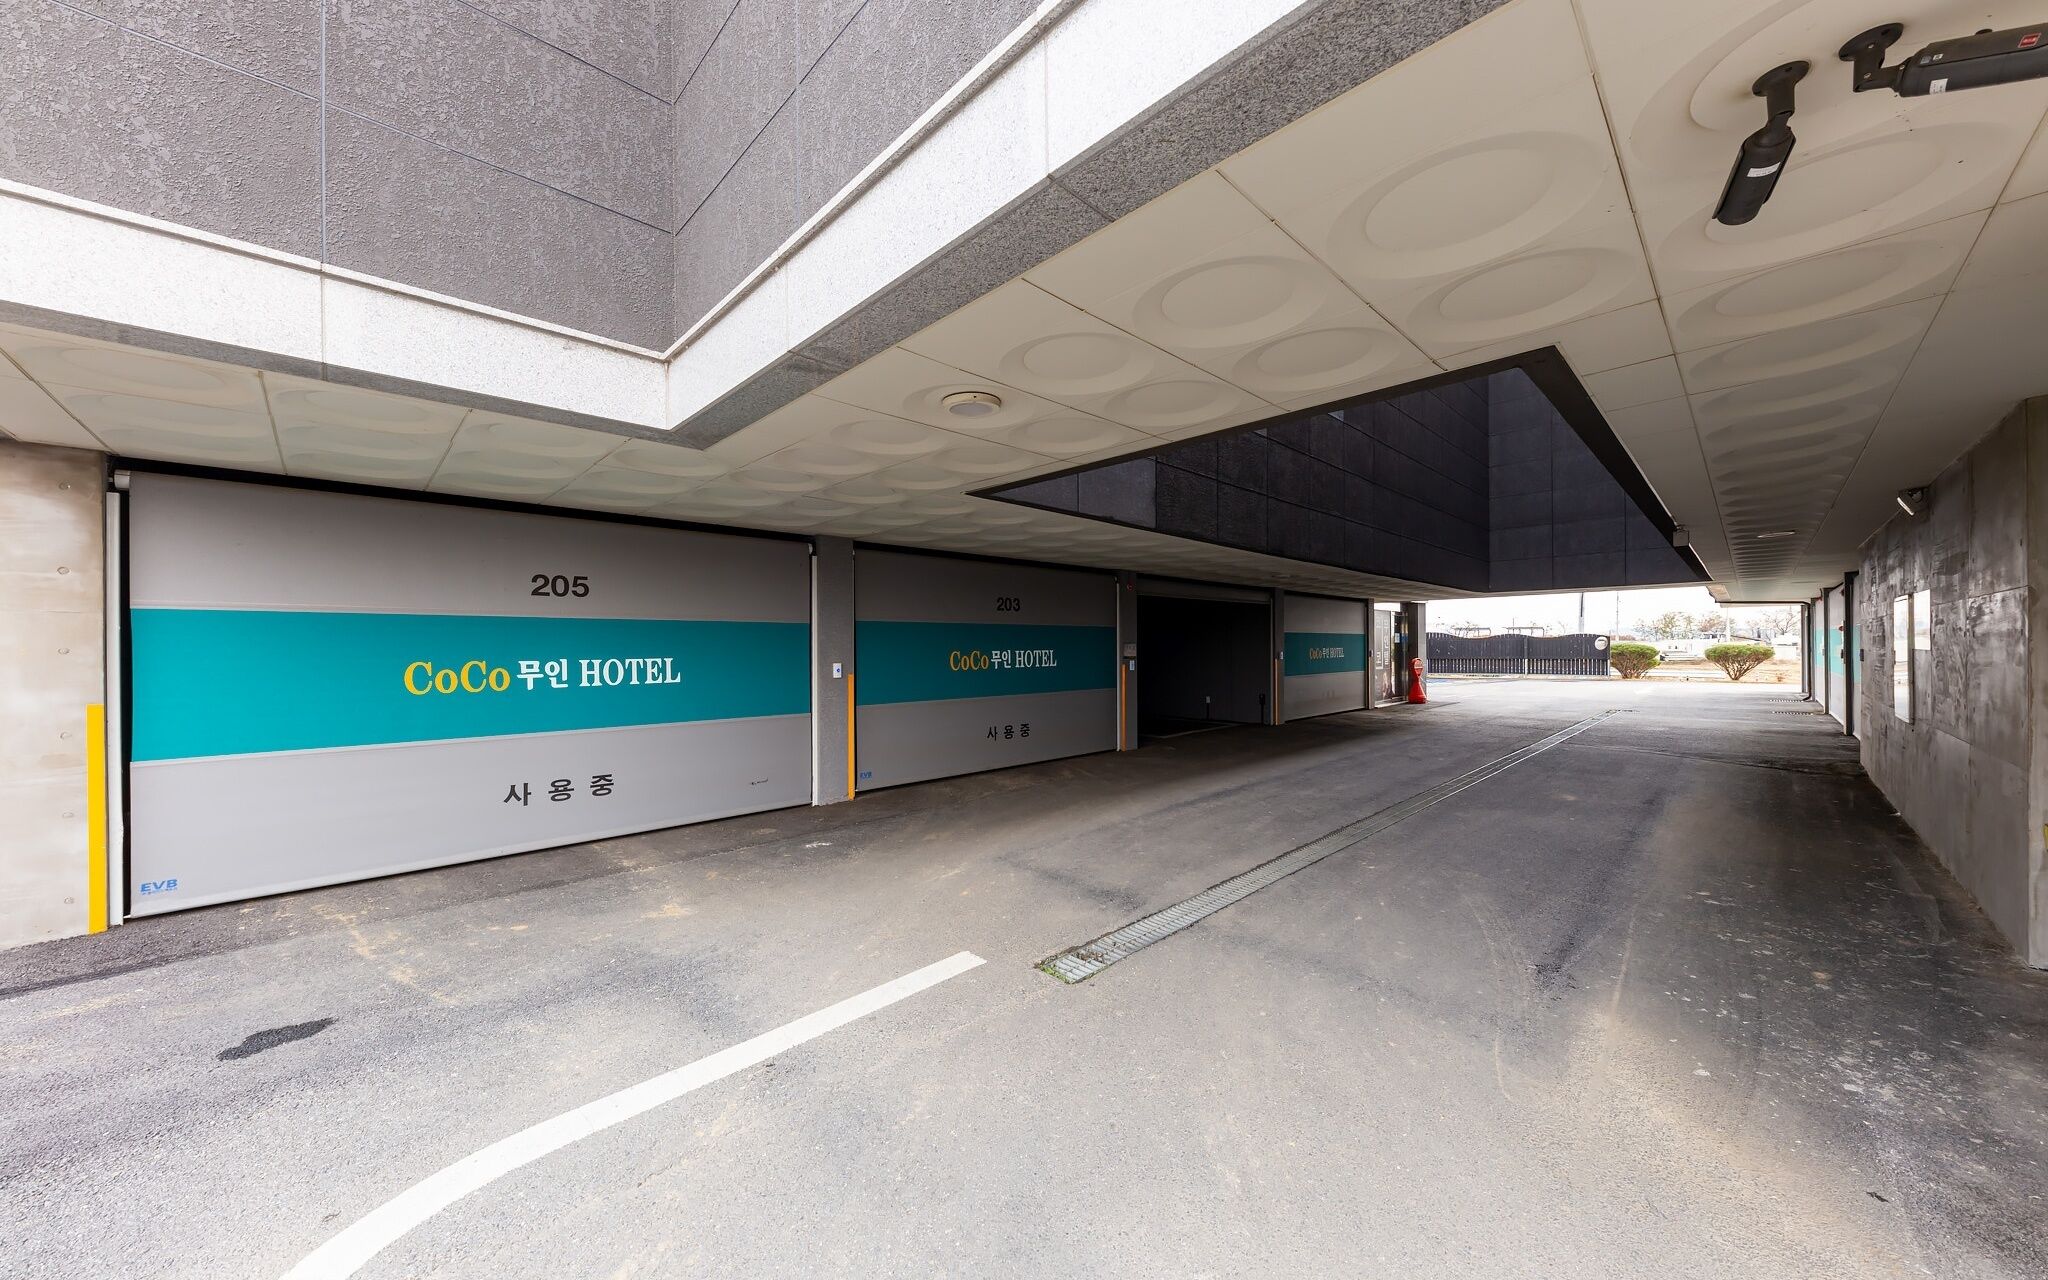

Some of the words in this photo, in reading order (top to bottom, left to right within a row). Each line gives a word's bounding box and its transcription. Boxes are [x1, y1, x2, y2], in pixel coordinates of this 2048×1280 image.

[531, 573, 590, 598] 205
[996, 597, 1021, 612] 203
[949, 650, 989, 671] CoCo
[990, 649, 1012, 670] 무인
[1015, 649, 1057, 668] HOTEL
[403, 659, 511, 696] CoCo
[516, 658, 569, 691] 무인
[579, 657, 681, 687] HOTEL
[140, 879, 178, 893] EVB
